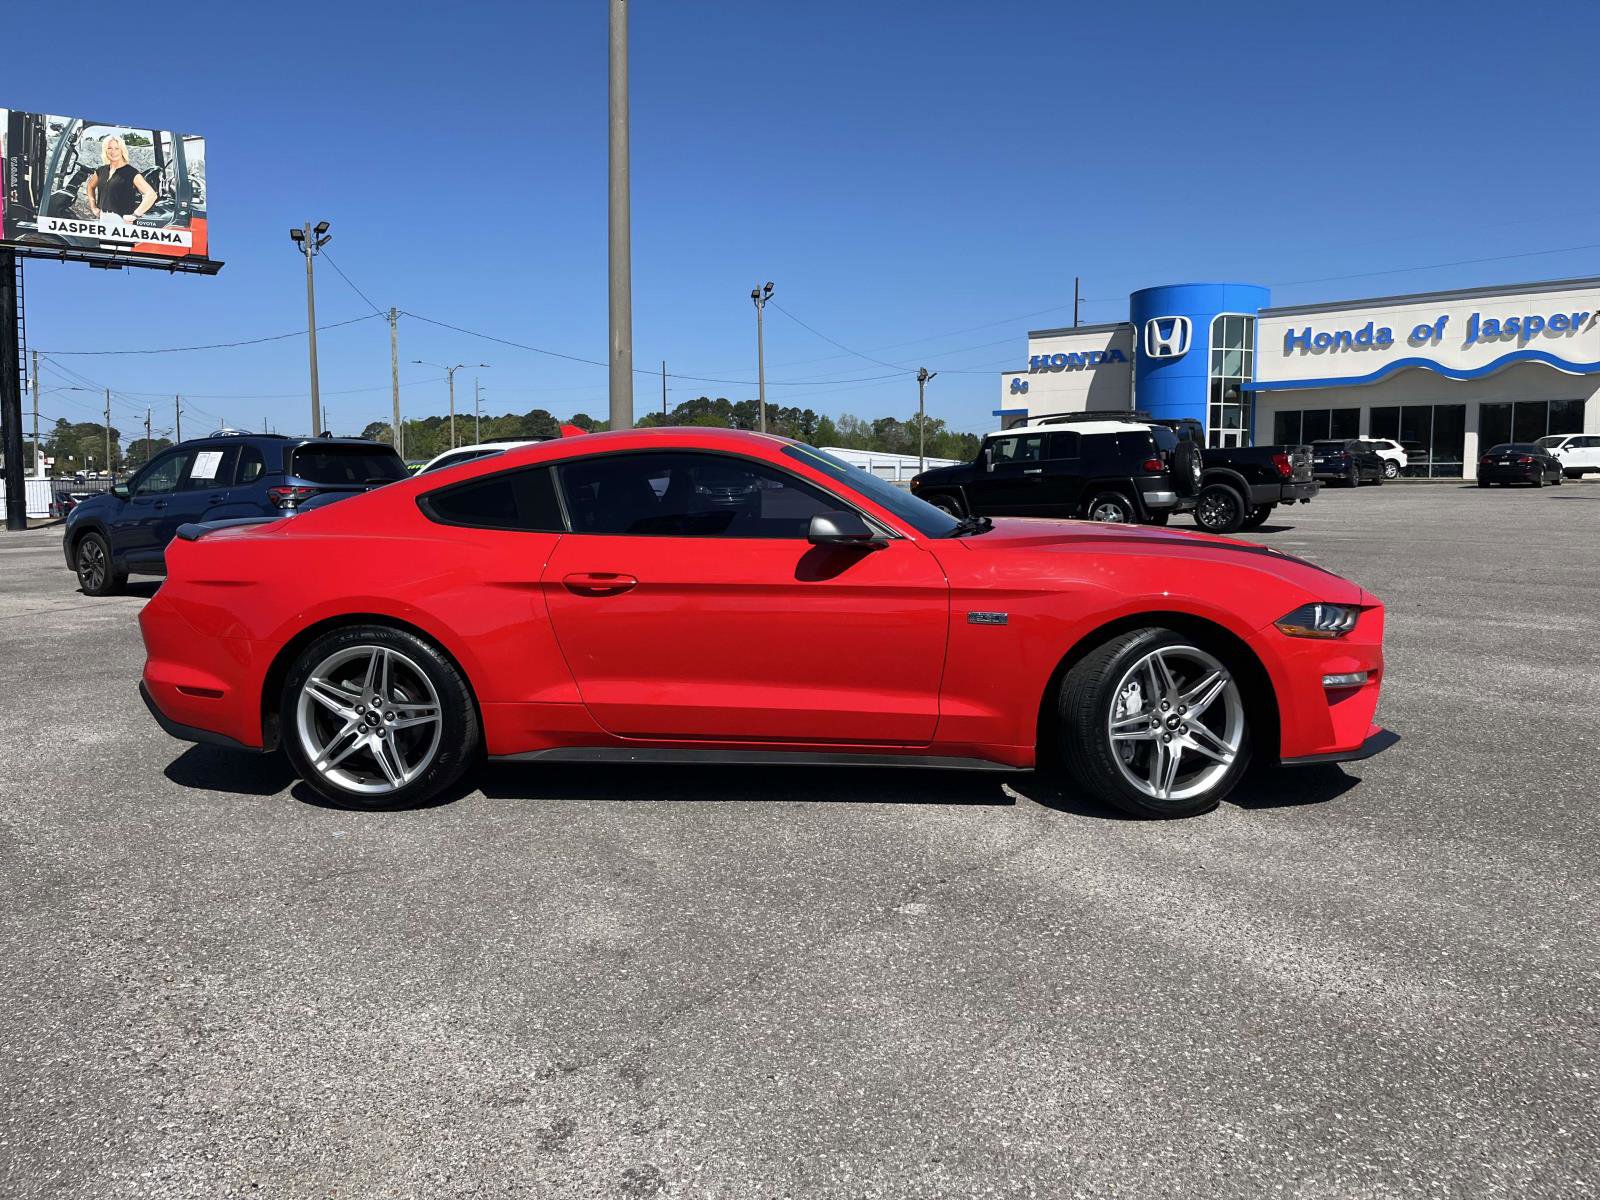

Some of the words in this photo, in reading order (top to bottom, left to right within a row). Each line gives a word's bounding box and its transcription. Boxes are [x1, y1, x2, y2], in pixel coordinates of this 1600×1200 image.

[48, 220, 107, 236] JASPER
[111, 227, 183, 244] ALABAMA
[1284, 321, 1393, 353] Honda
[1410, 315, 1450, 342] of
[1463, 311, 1590, 345] Jasper
[1030, 350, 1128, 369] HONDA
